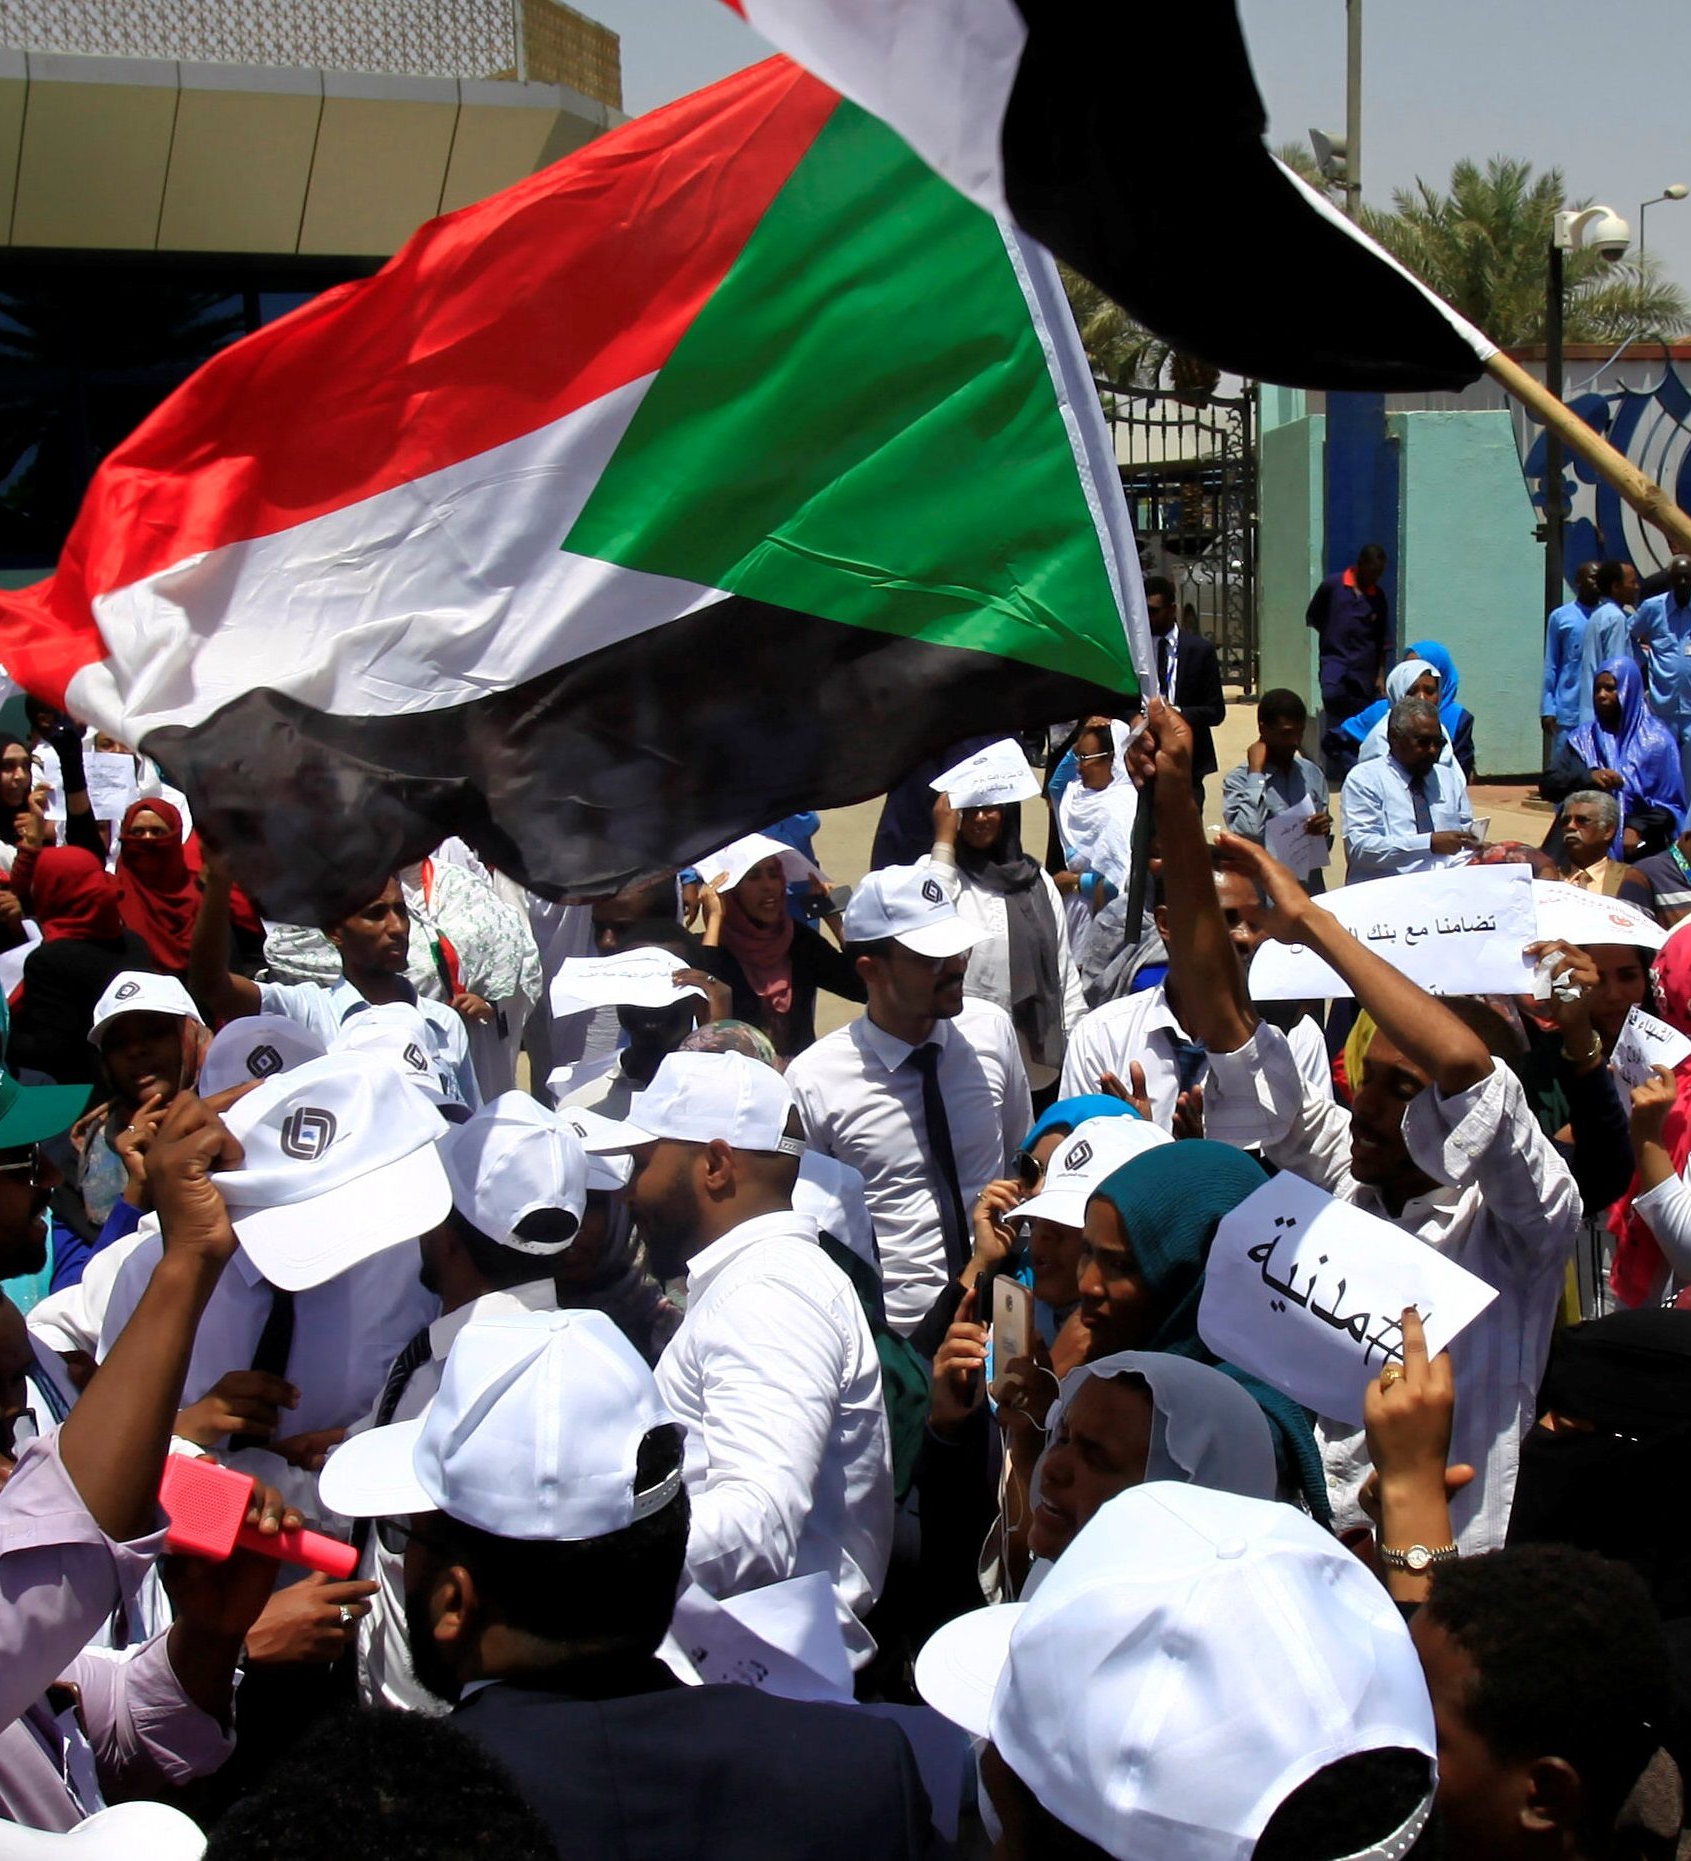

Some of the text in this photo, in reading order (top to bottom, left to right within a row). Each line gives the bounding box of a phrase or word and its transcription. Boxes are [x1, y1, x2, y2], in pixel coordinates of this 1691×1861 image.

[1366, 923, 1397, 944] بنك
[1435, 914, 1497, 935] تضامنا
[1405, 925, 1429, 946] مع
